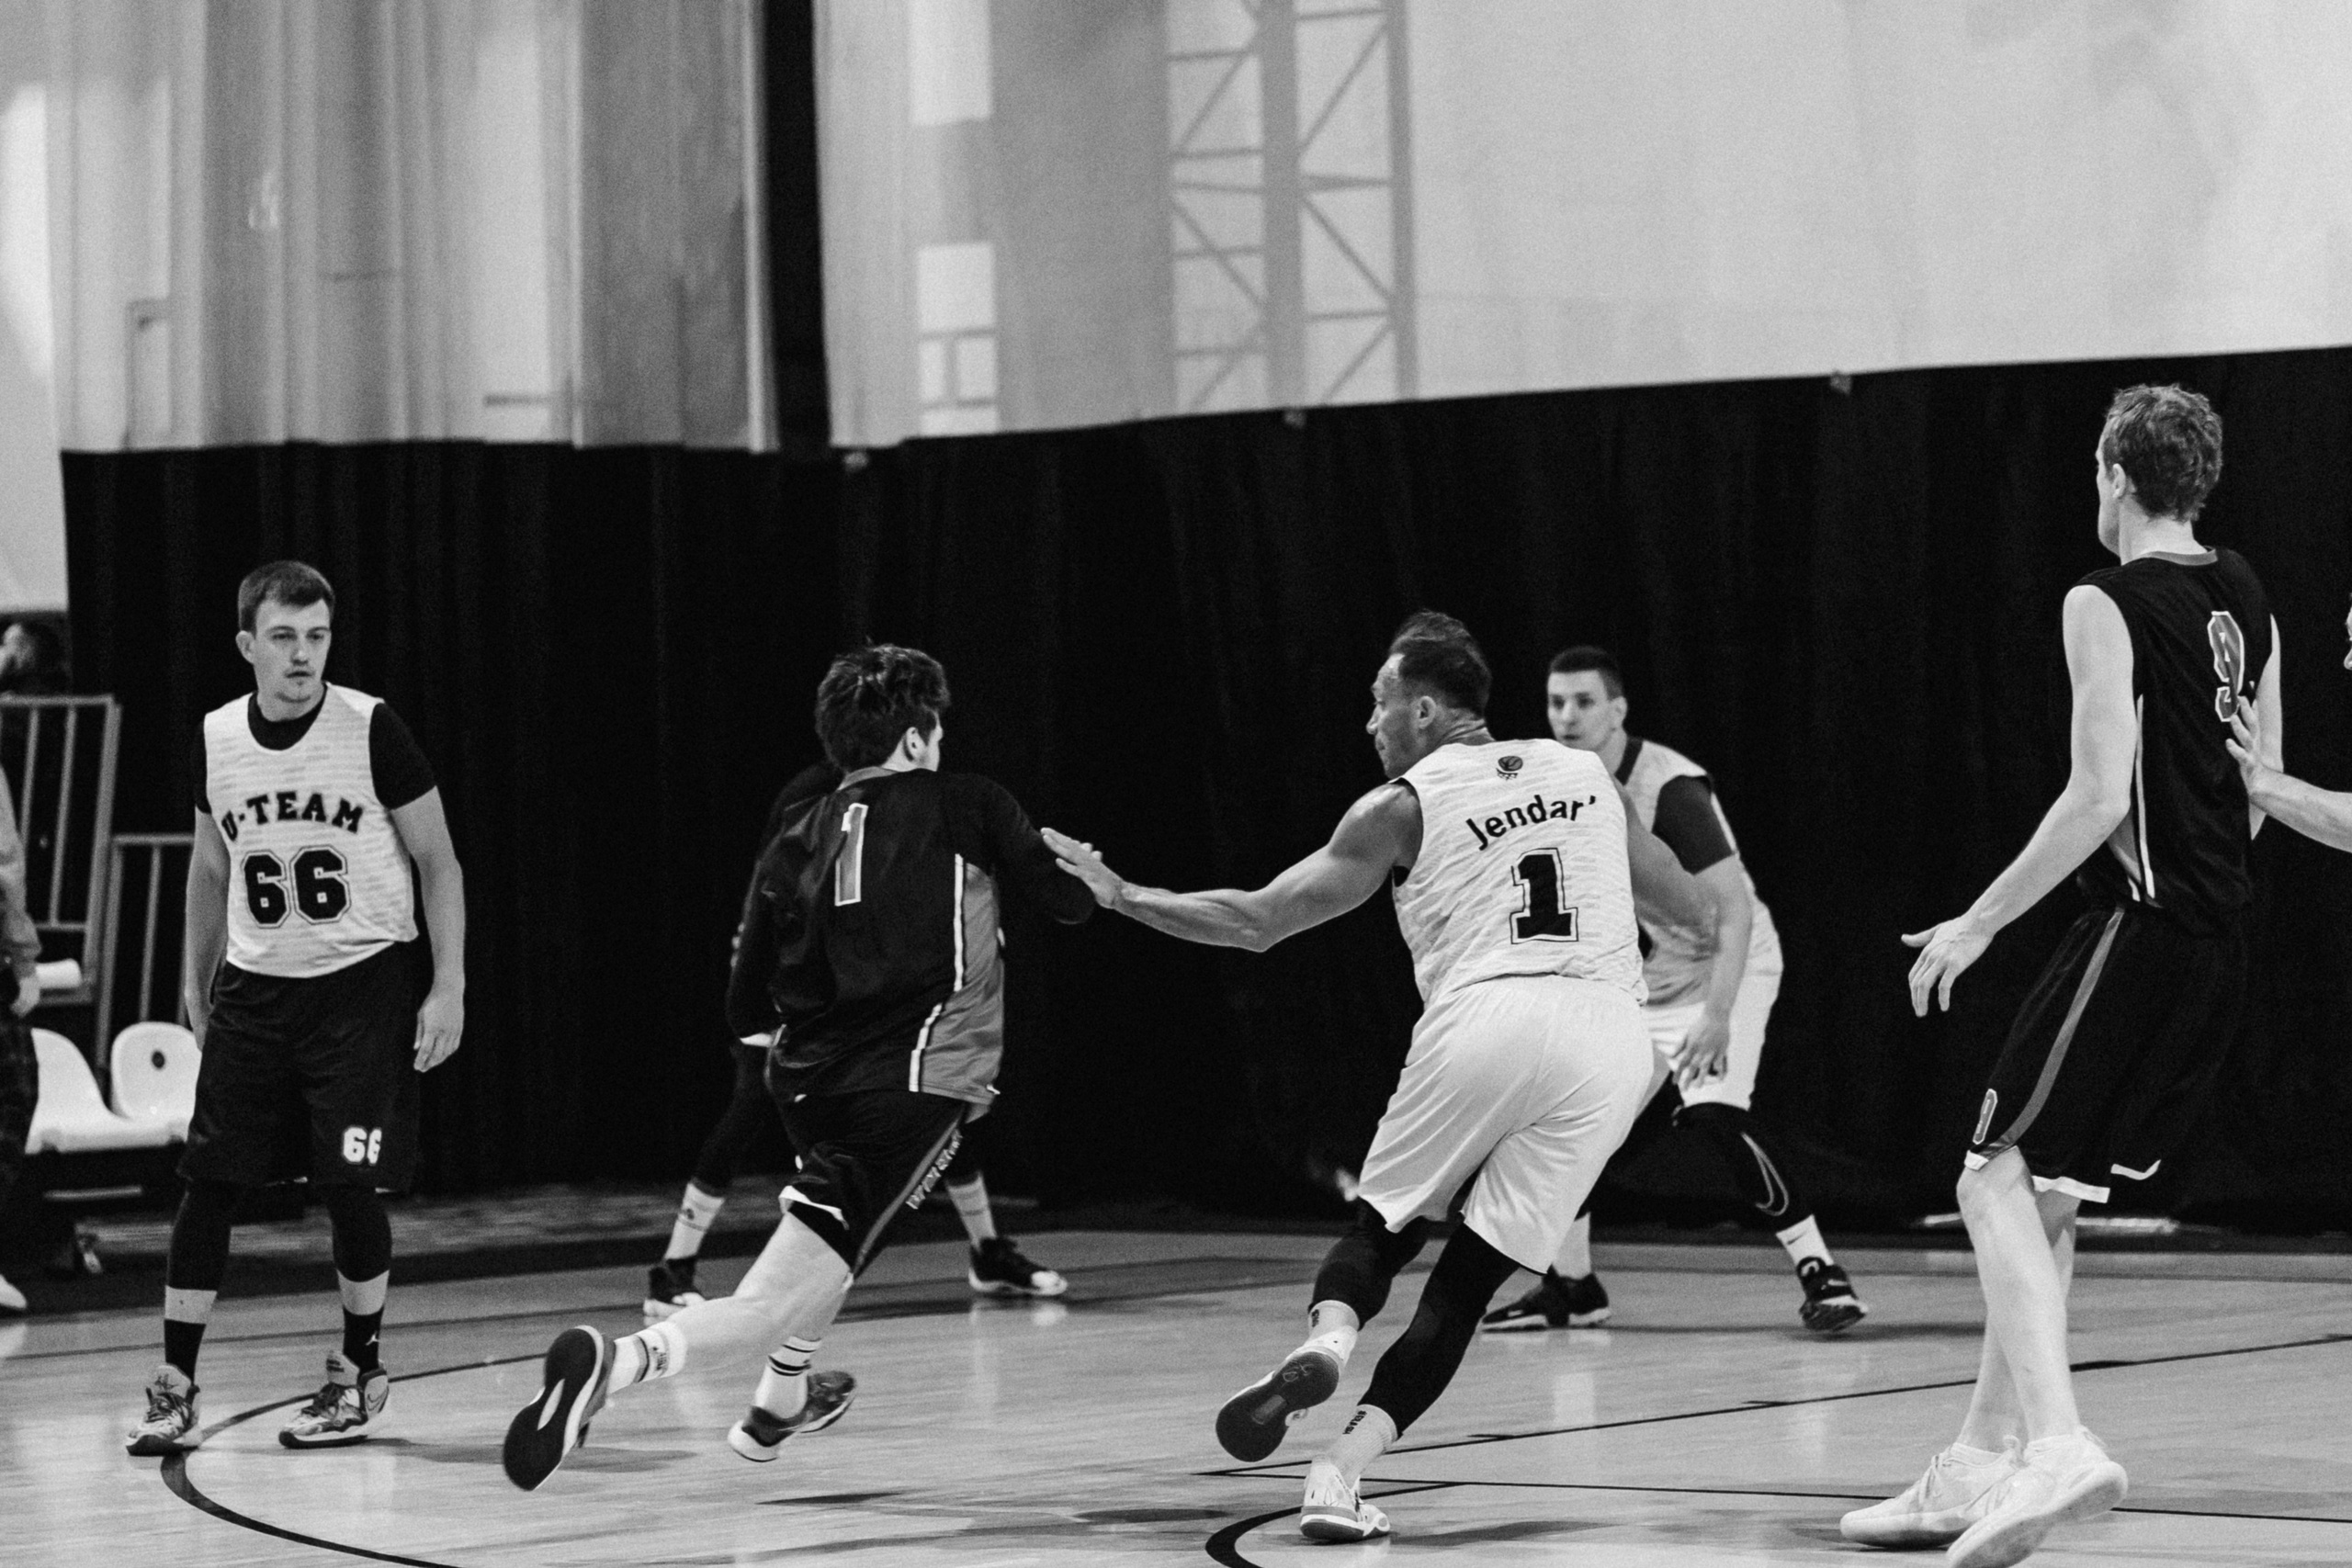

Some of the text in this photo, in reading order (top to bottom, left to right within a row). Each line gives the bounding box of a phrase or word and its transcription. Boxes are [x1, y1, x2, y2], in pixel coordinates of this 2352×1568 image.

[240, 843, 352, 929] 66
[834, 803, 868, 907] 1
[1510, 847, 1579, 945] 1
[342, 1125, 382, 1166] 66
